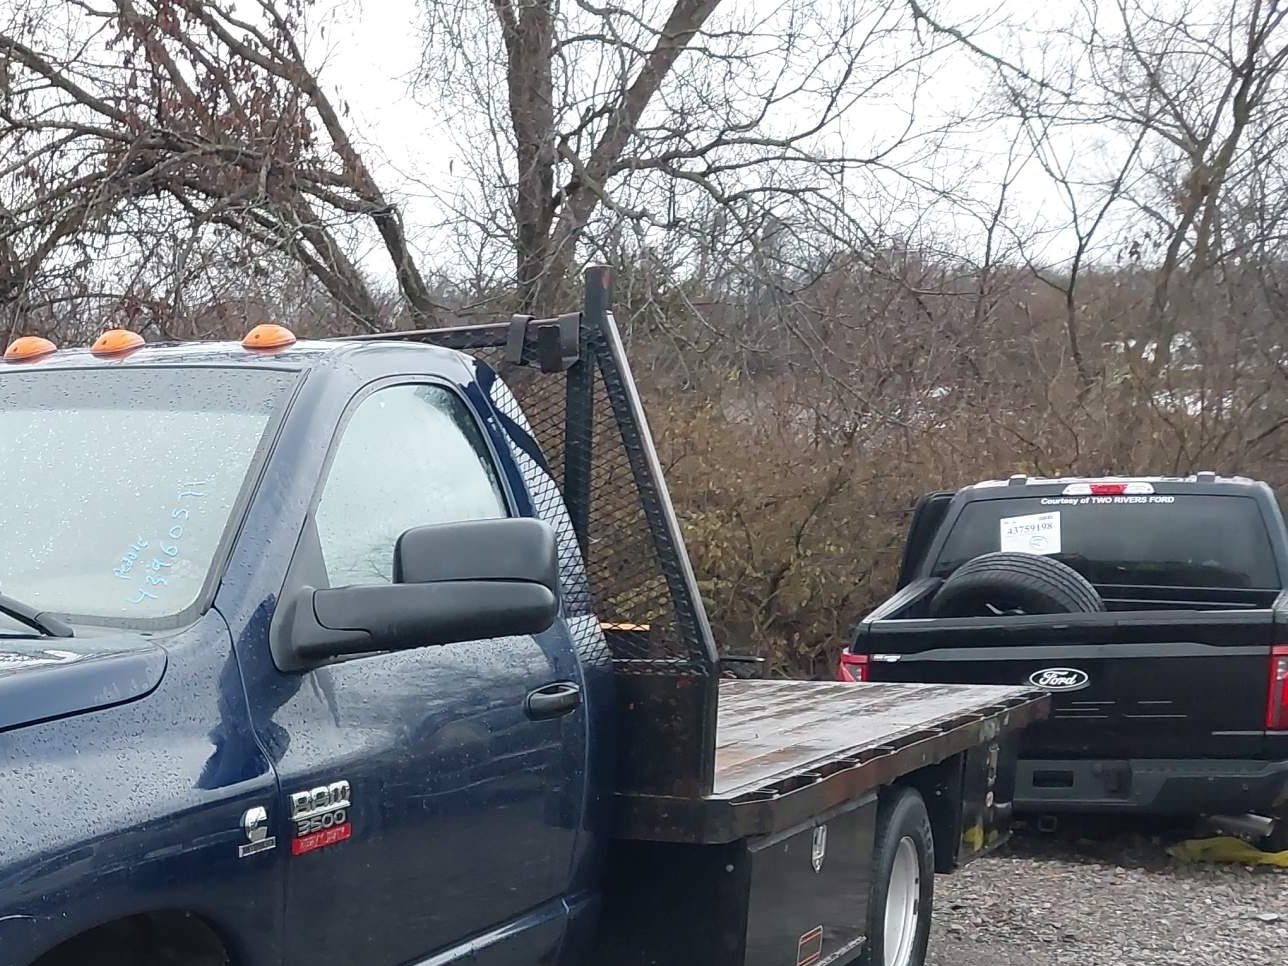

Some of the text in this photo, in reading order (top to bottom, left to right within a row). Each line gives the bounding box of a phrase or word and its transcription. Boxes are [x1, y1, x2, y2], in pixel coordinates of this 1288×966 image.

[1040, 496, 1176, 506] Courtesy of TWO RIVERS FORD
[128, 480, 208, 604] 43960571
[1038, 671, 1078, 686] Ford
[290, 780, 350, 815] RAM
[297, 808, 347, 837] 3500
